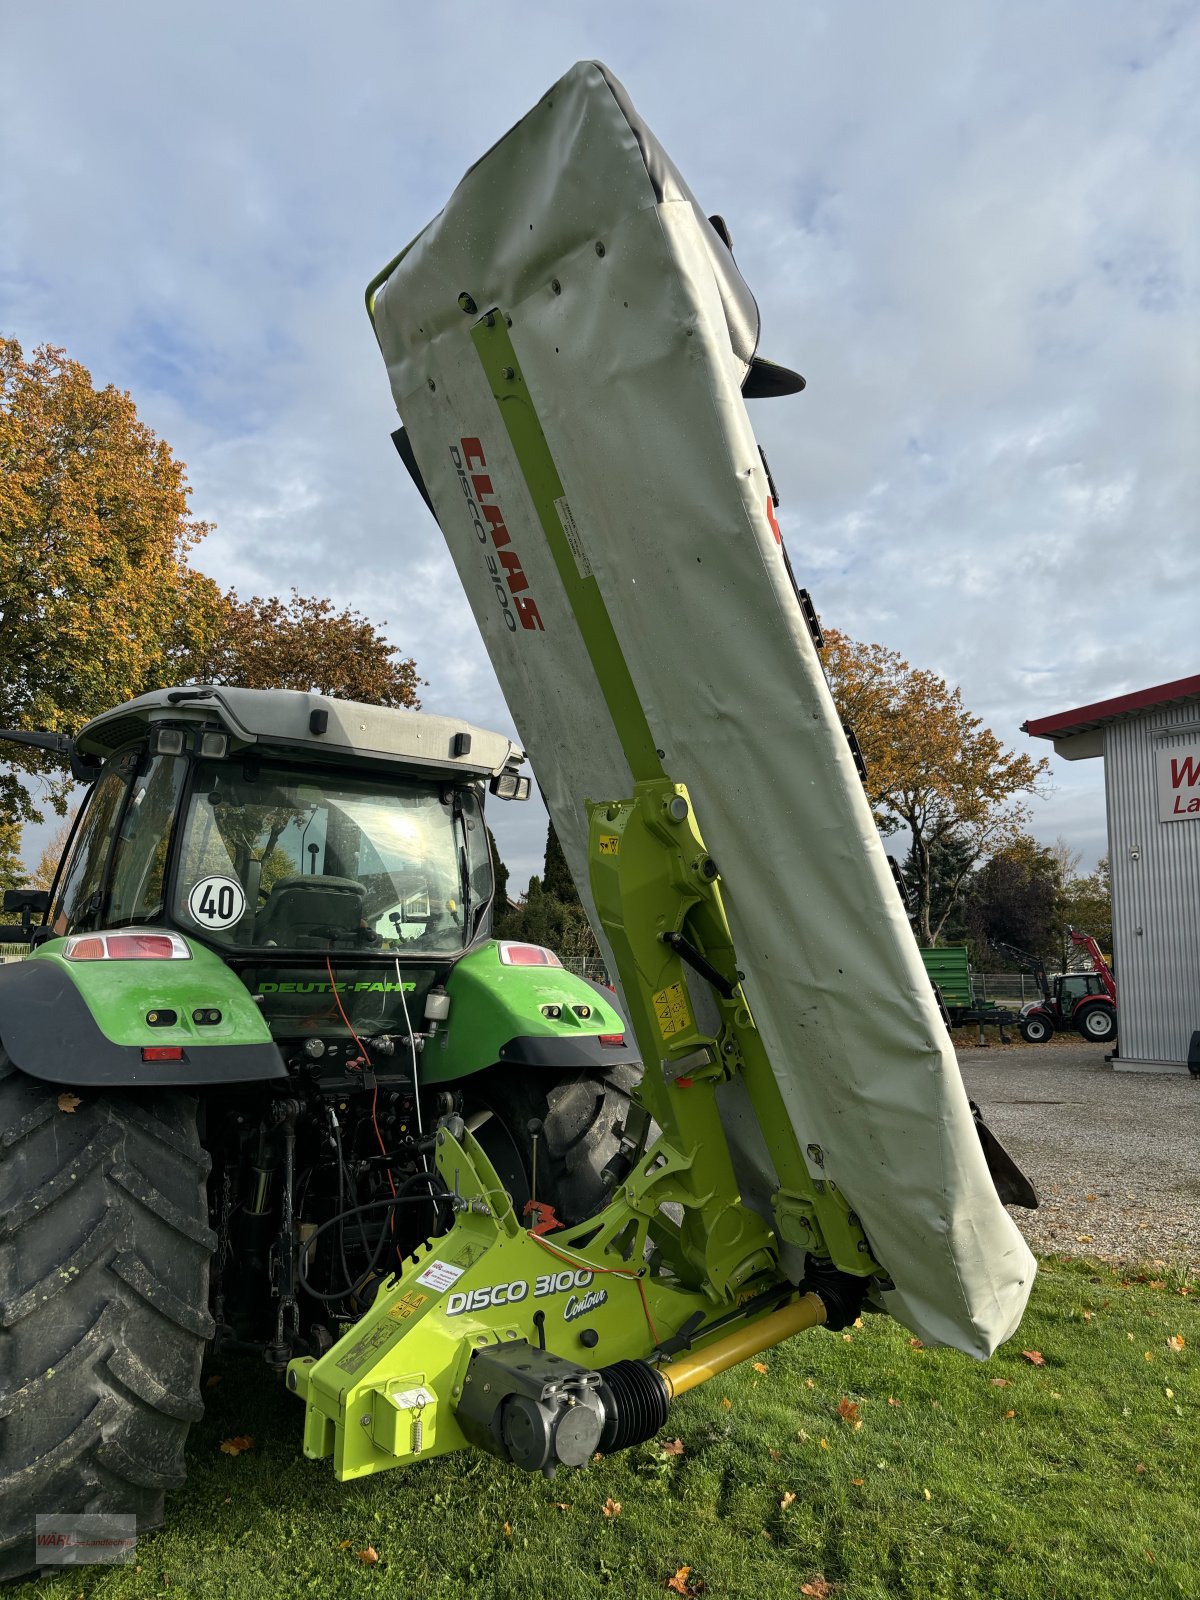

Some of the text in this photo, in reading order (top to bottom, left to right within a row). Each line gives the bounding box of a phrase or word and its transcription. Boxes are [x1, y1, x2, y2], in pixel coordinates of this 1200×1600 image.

[449, 445, 517, 633] DISCO 3100
[460, 437, 546, 632] CLAAS
[1170, 756, 1200, 789] W
[198, 884, 235, 920] 40
[258, 982, 417, 993] DEUTZ-FAHR
[446, 1267, 594, 1317] DISCO 3100
[563, 1289, 608, 1322] Contour
